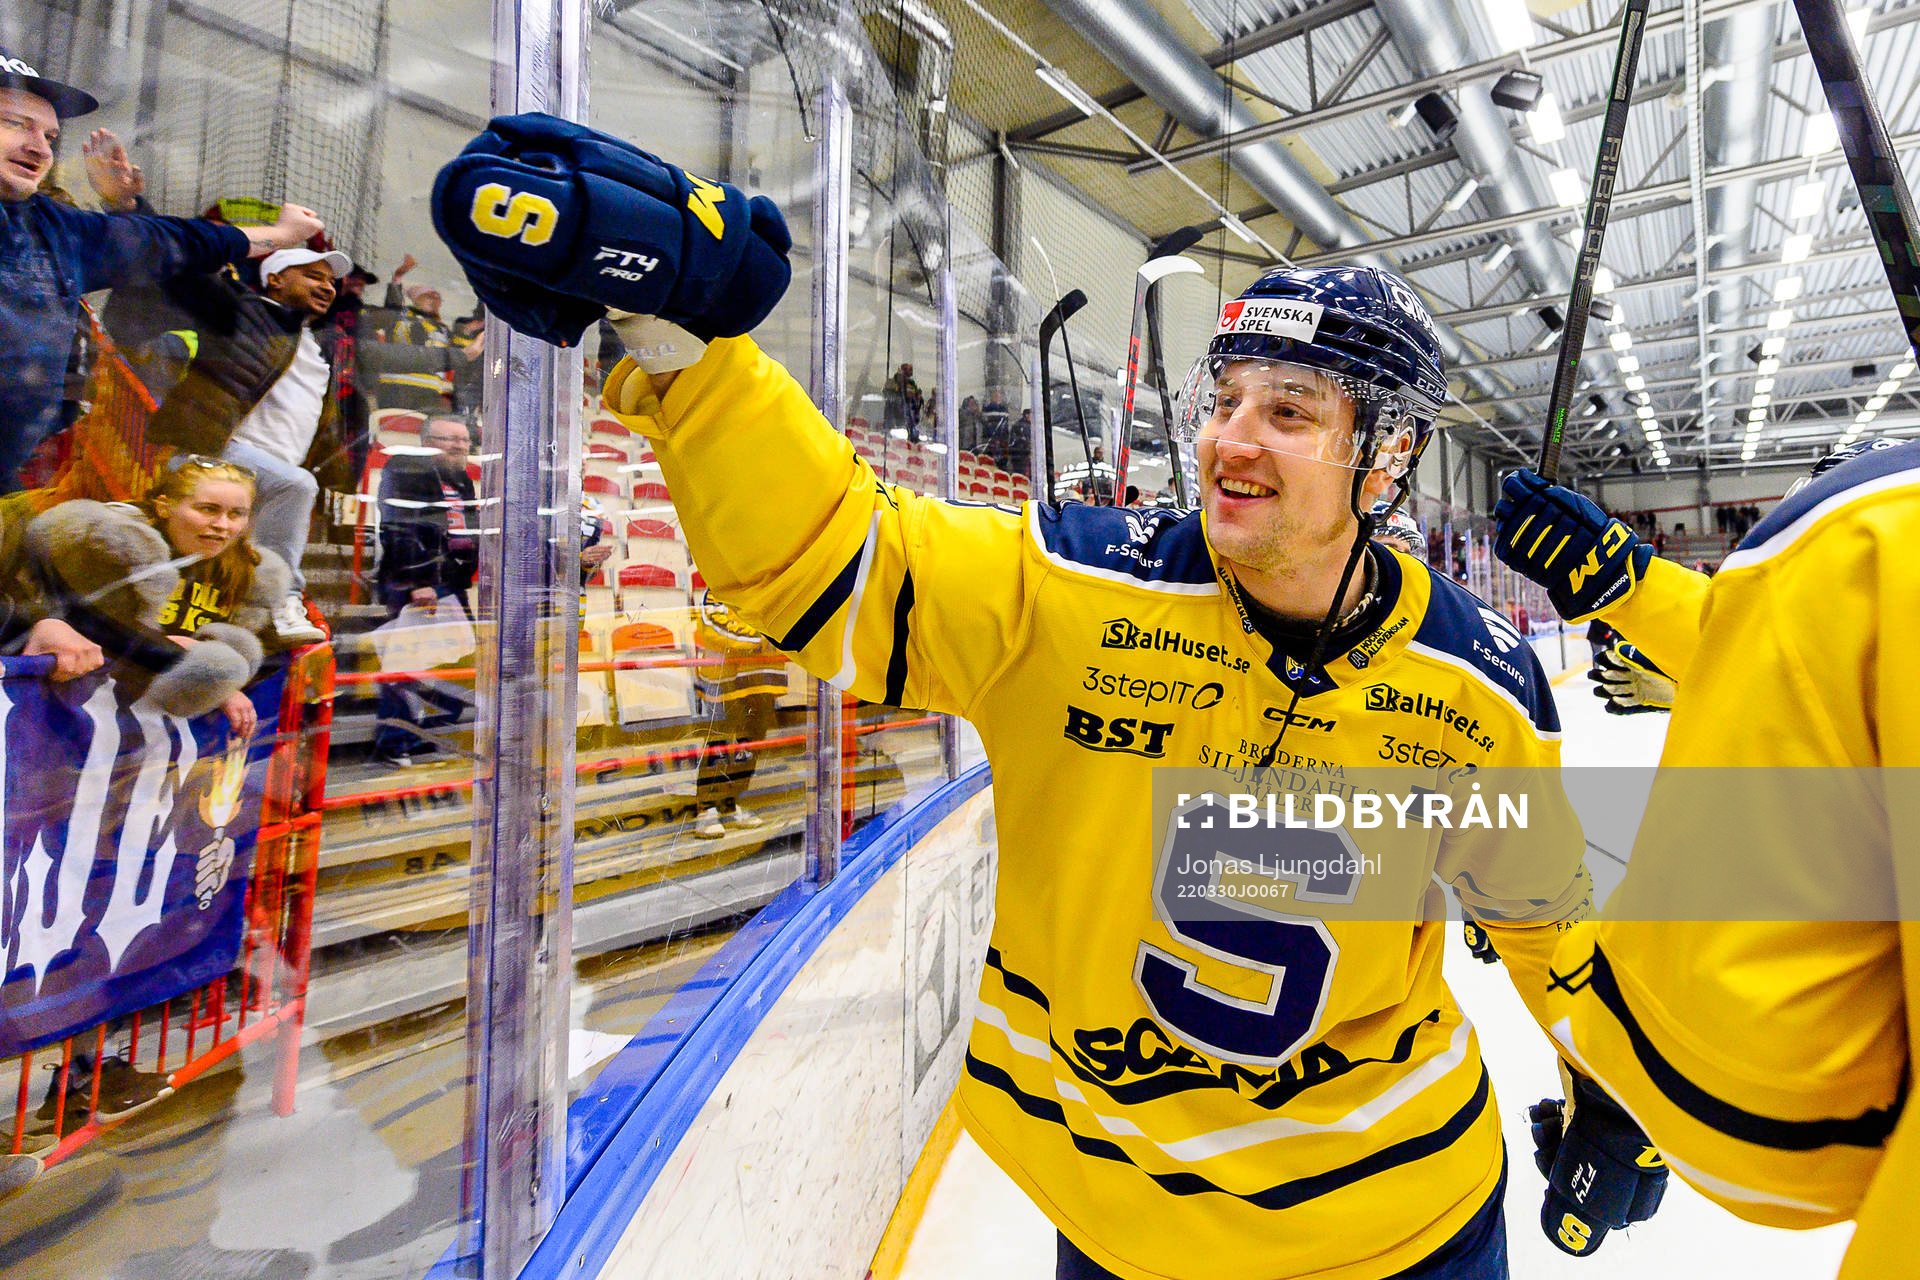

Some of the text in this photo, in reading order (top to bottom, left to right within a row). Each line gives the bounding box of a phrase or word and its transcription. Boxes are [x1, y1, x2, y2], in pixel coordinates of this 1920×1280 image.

[470, 182, 560, 247] S
[1575, 136, 1622, 309] RIBCORE
[600, 266, 644, 282] PRO
[1238, 318, 1273, 333] SPEL
[1246, 305, 1314, 326] SVENSKA
[1416, 376, 1445, 399] CCM
[1568, 522, 1633, 595] CM
[1107, 623, 1250, 674] SkalHuset.se
[1360, 626, 1386, 650] HOCKEY
[1367, 616, 1410, 658] ALLSVENSKAN
[1473, 639, 1525, 687] F-Secure
[1064, 704, 1175, 755] BST
[1263, 707, 1337, 732] CCM
[1132, 790, 1363, 1067] S
[1570, 1162, 1584, 1190] PRO
[1557, 1212, 1593, 1252] S
